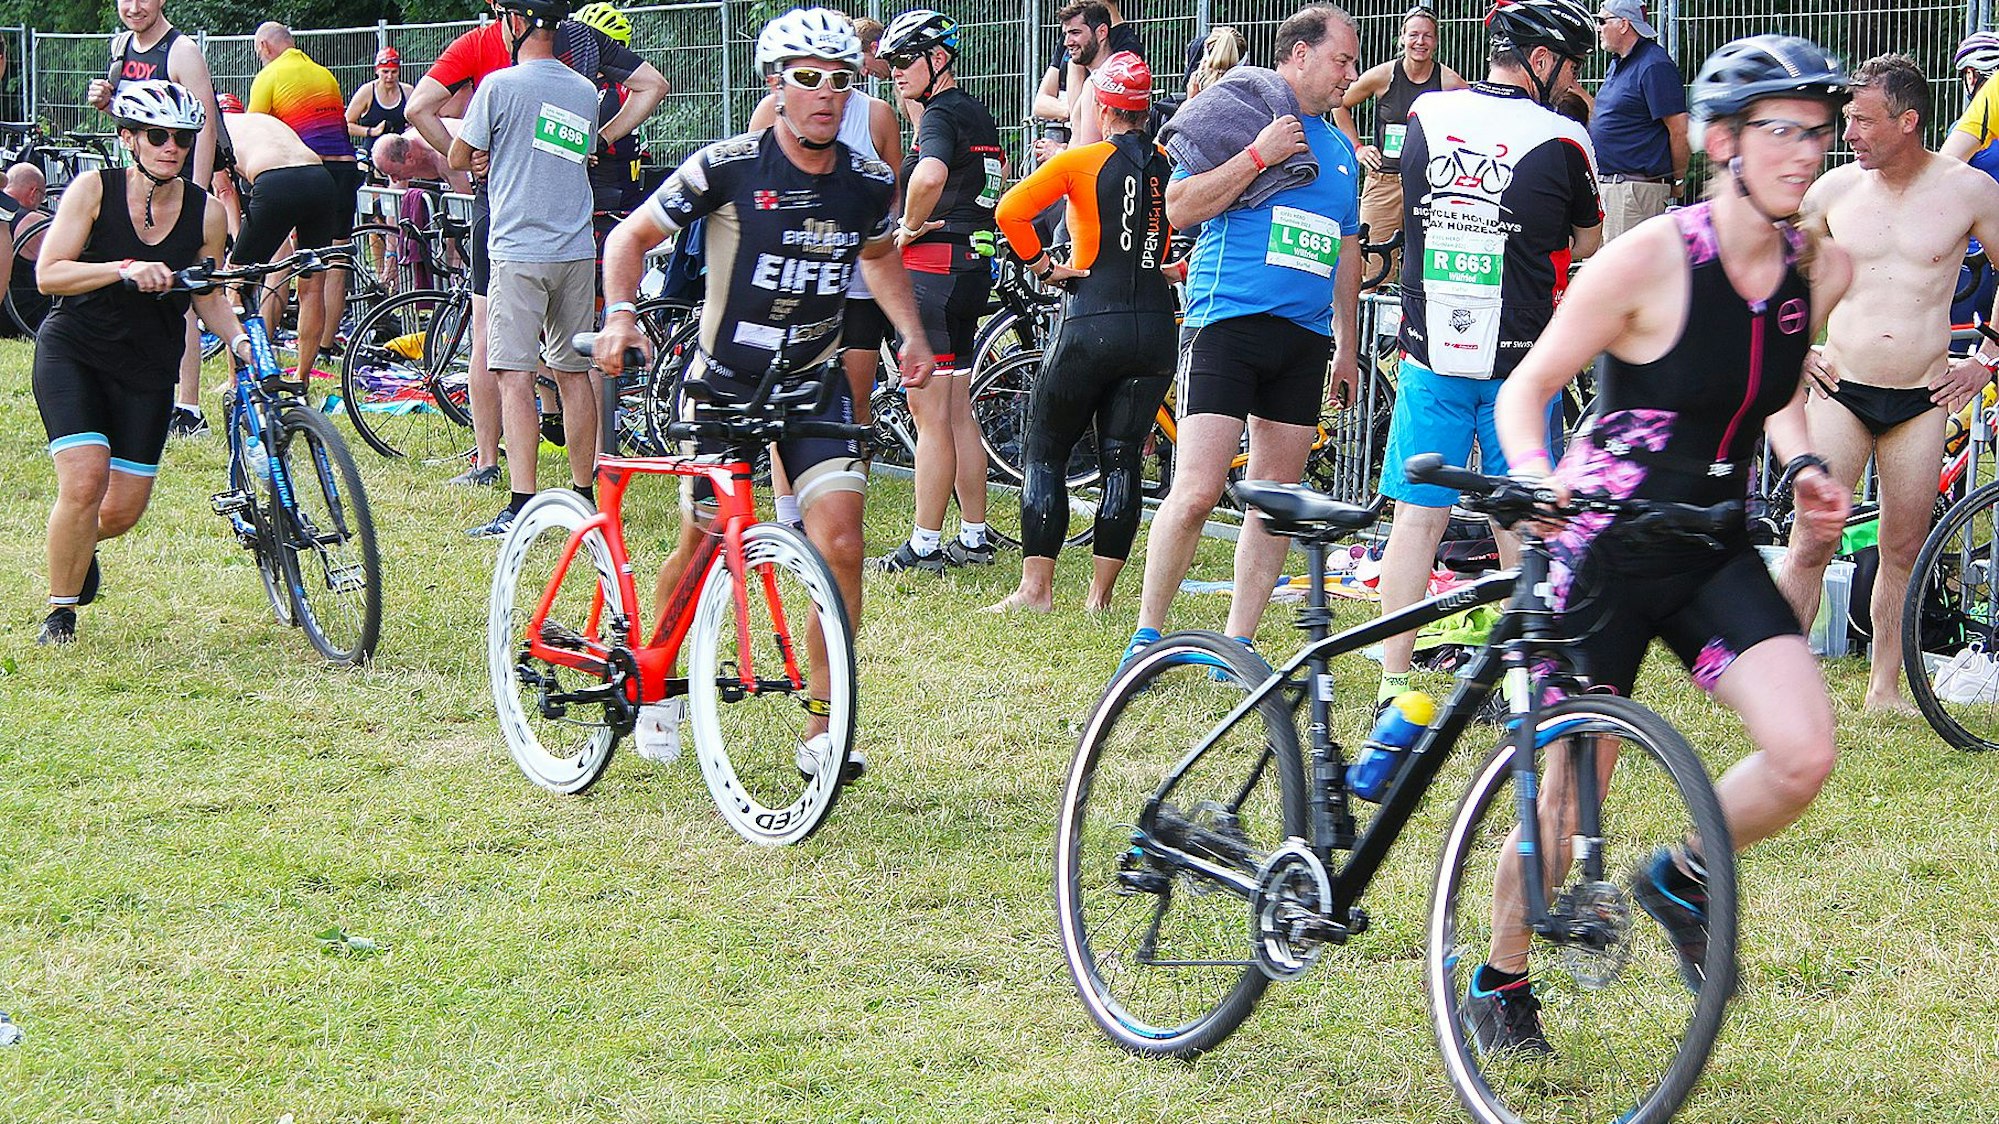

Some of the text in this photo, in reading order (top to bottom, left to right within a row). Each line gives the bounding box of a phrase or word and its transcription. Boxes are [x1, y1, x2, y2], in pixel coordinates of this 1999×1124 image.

[543, 119, 584, 146] R 698
[1120, 175, 1136, 252] orca
[1412, 206, 1458, 220] BICYCLE
[1421, 219, 1444, 229] MAX
[1282, 227, 1332, 255] L 663
[1433, 250, 1493, 275] R 663
[1448, 271, 1477, 284] Wilfried
[1500, 340, 1513, 349] DT
